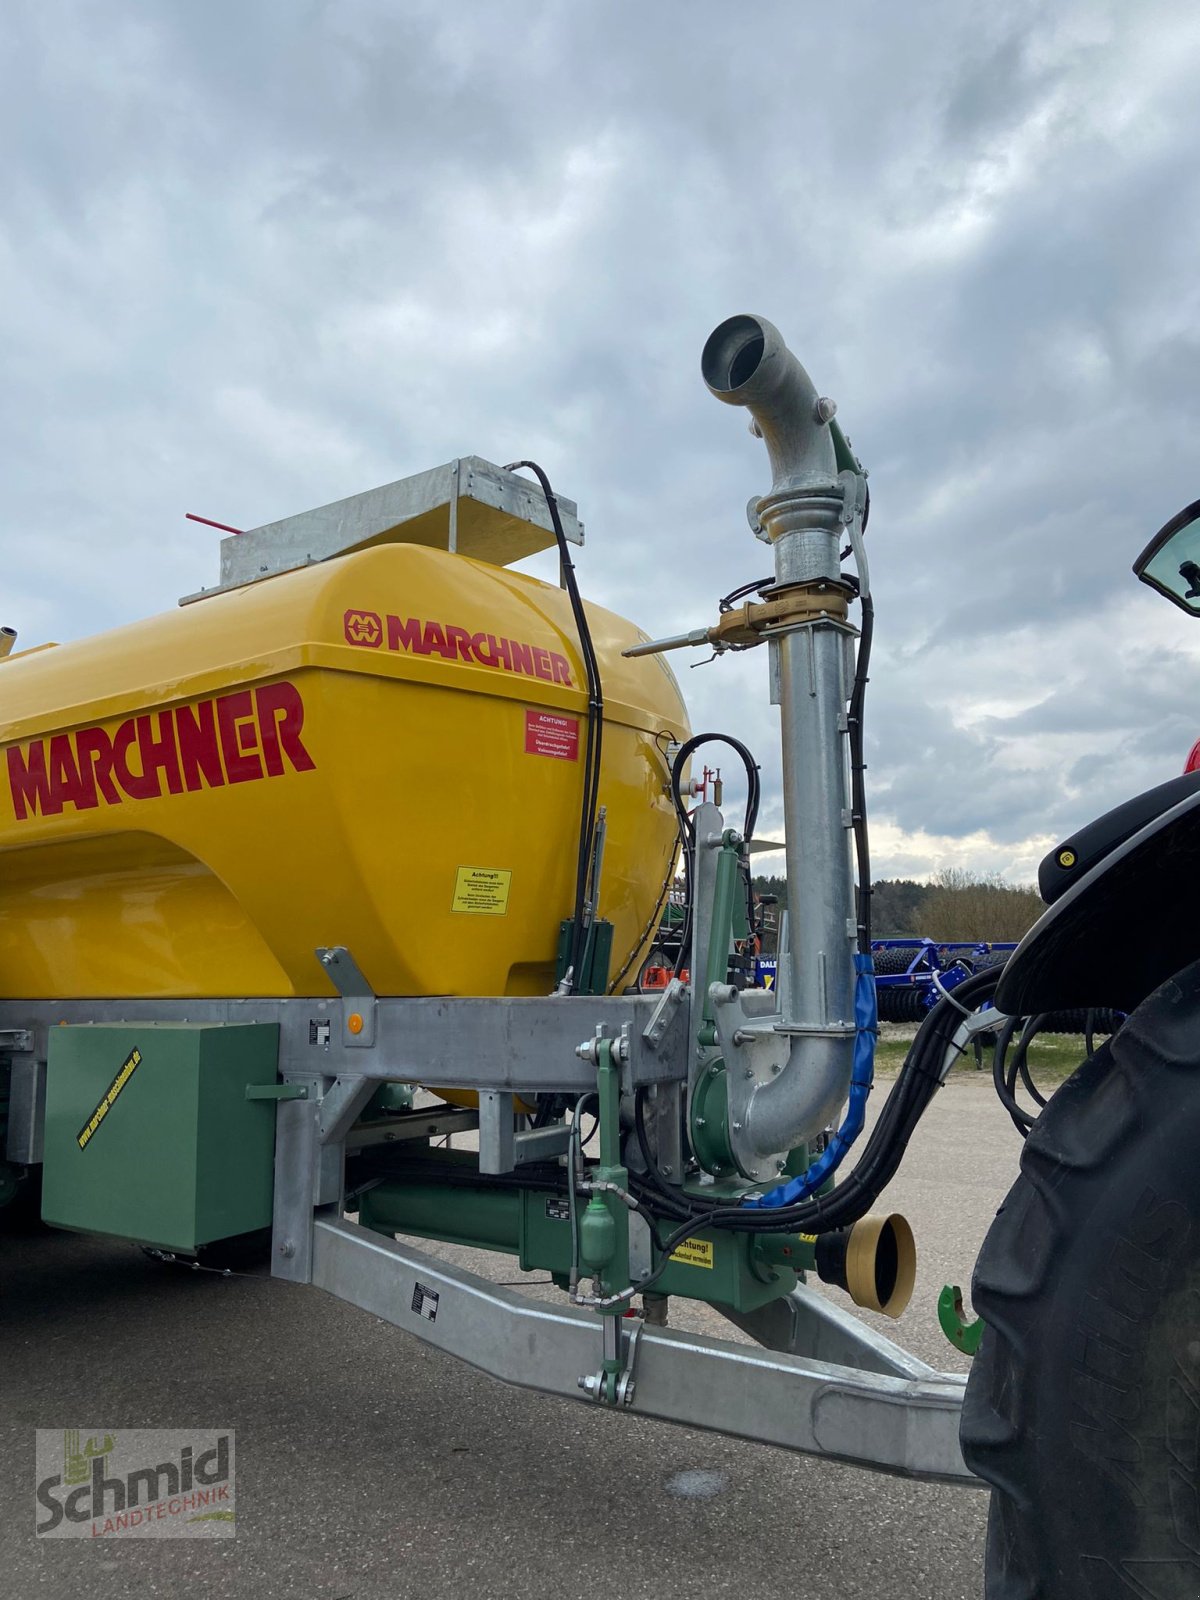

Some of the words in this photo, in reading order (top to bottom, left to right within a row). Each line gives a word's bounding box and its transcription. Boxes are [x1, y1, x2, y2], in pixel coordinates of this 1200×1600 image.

[388, 615, 573, 687] MARCHNER
[6, 681, 316, 821] MARCHNER
[539, 715, 568, 727] ACHTUNG!
